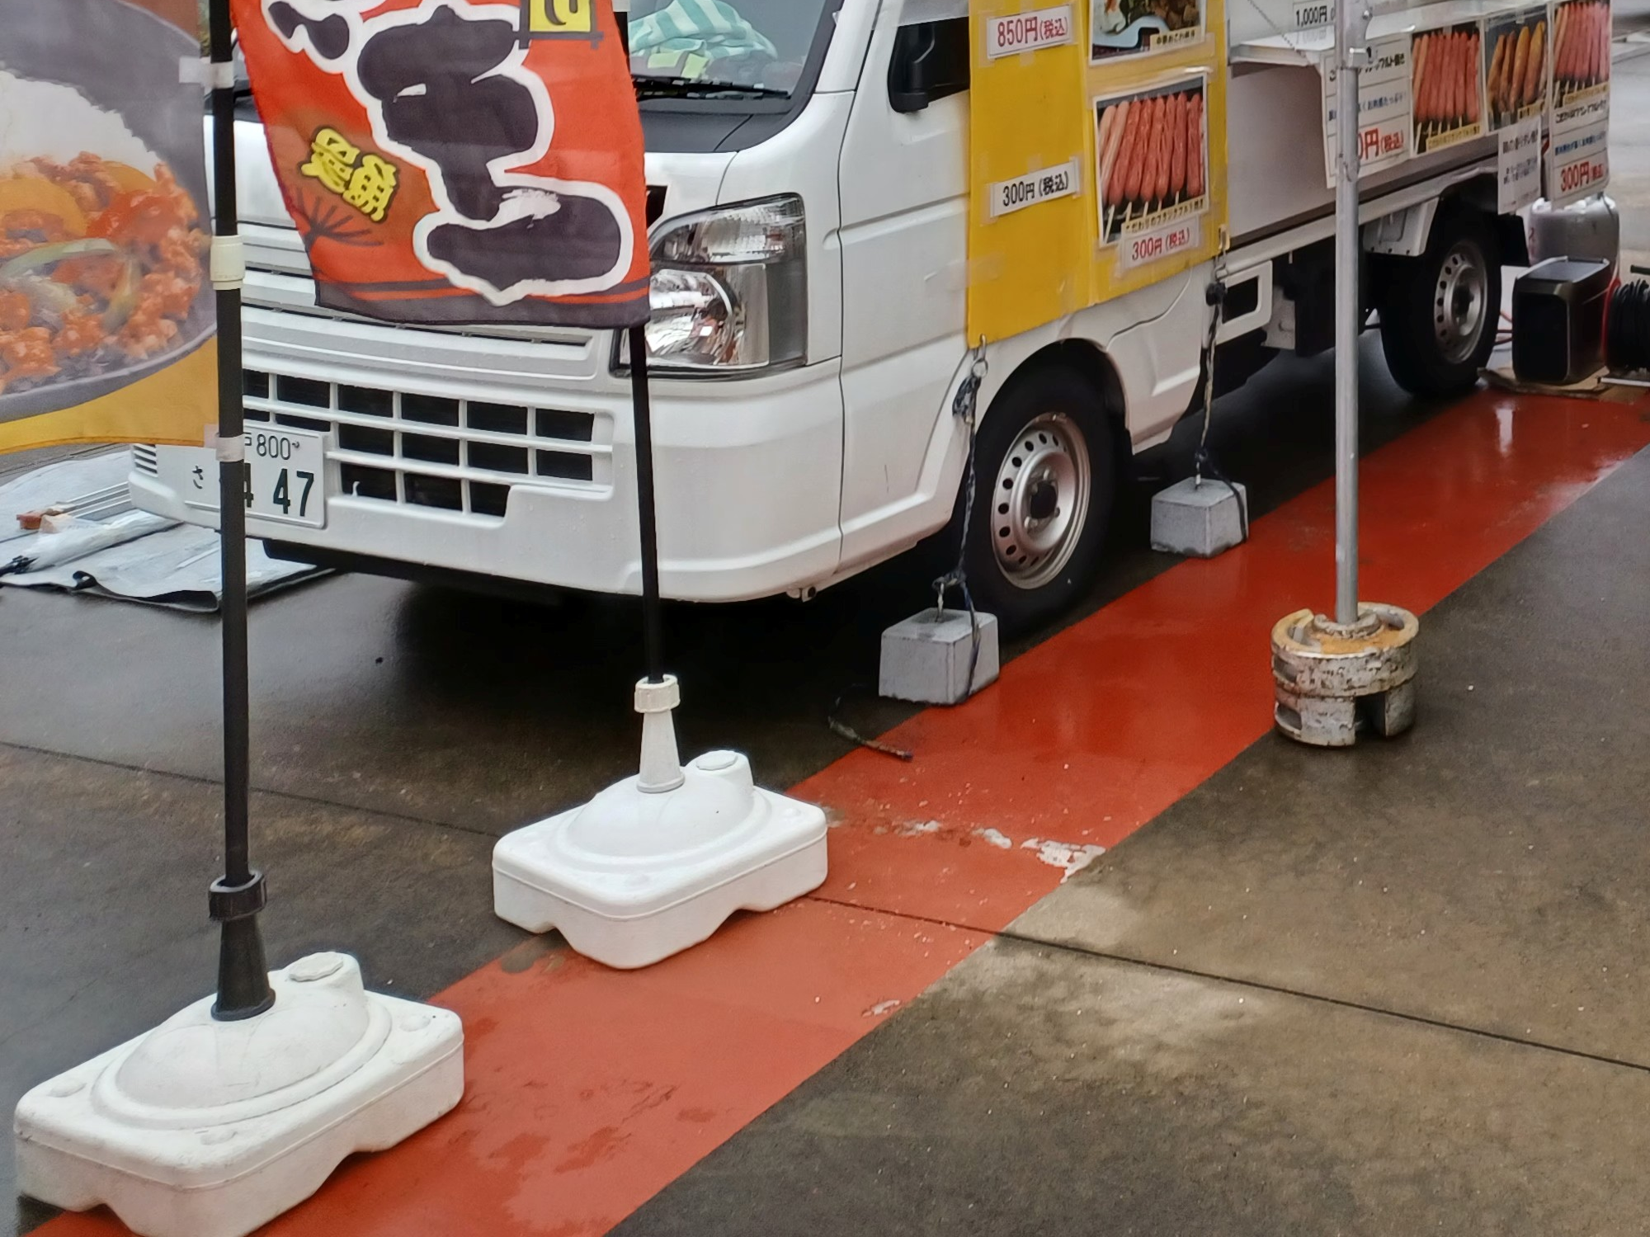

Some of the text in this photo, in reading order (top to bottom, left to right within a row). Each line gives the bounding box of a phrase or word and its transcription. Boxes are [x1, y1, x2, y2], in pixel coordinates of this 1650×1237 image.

[1003, 170, 1070, 207] 300円 (税込)
[1132, 236, 1163, 261] 300円
[256, 433, 291, 461] 800
[272, 467, 315, 517] 47
